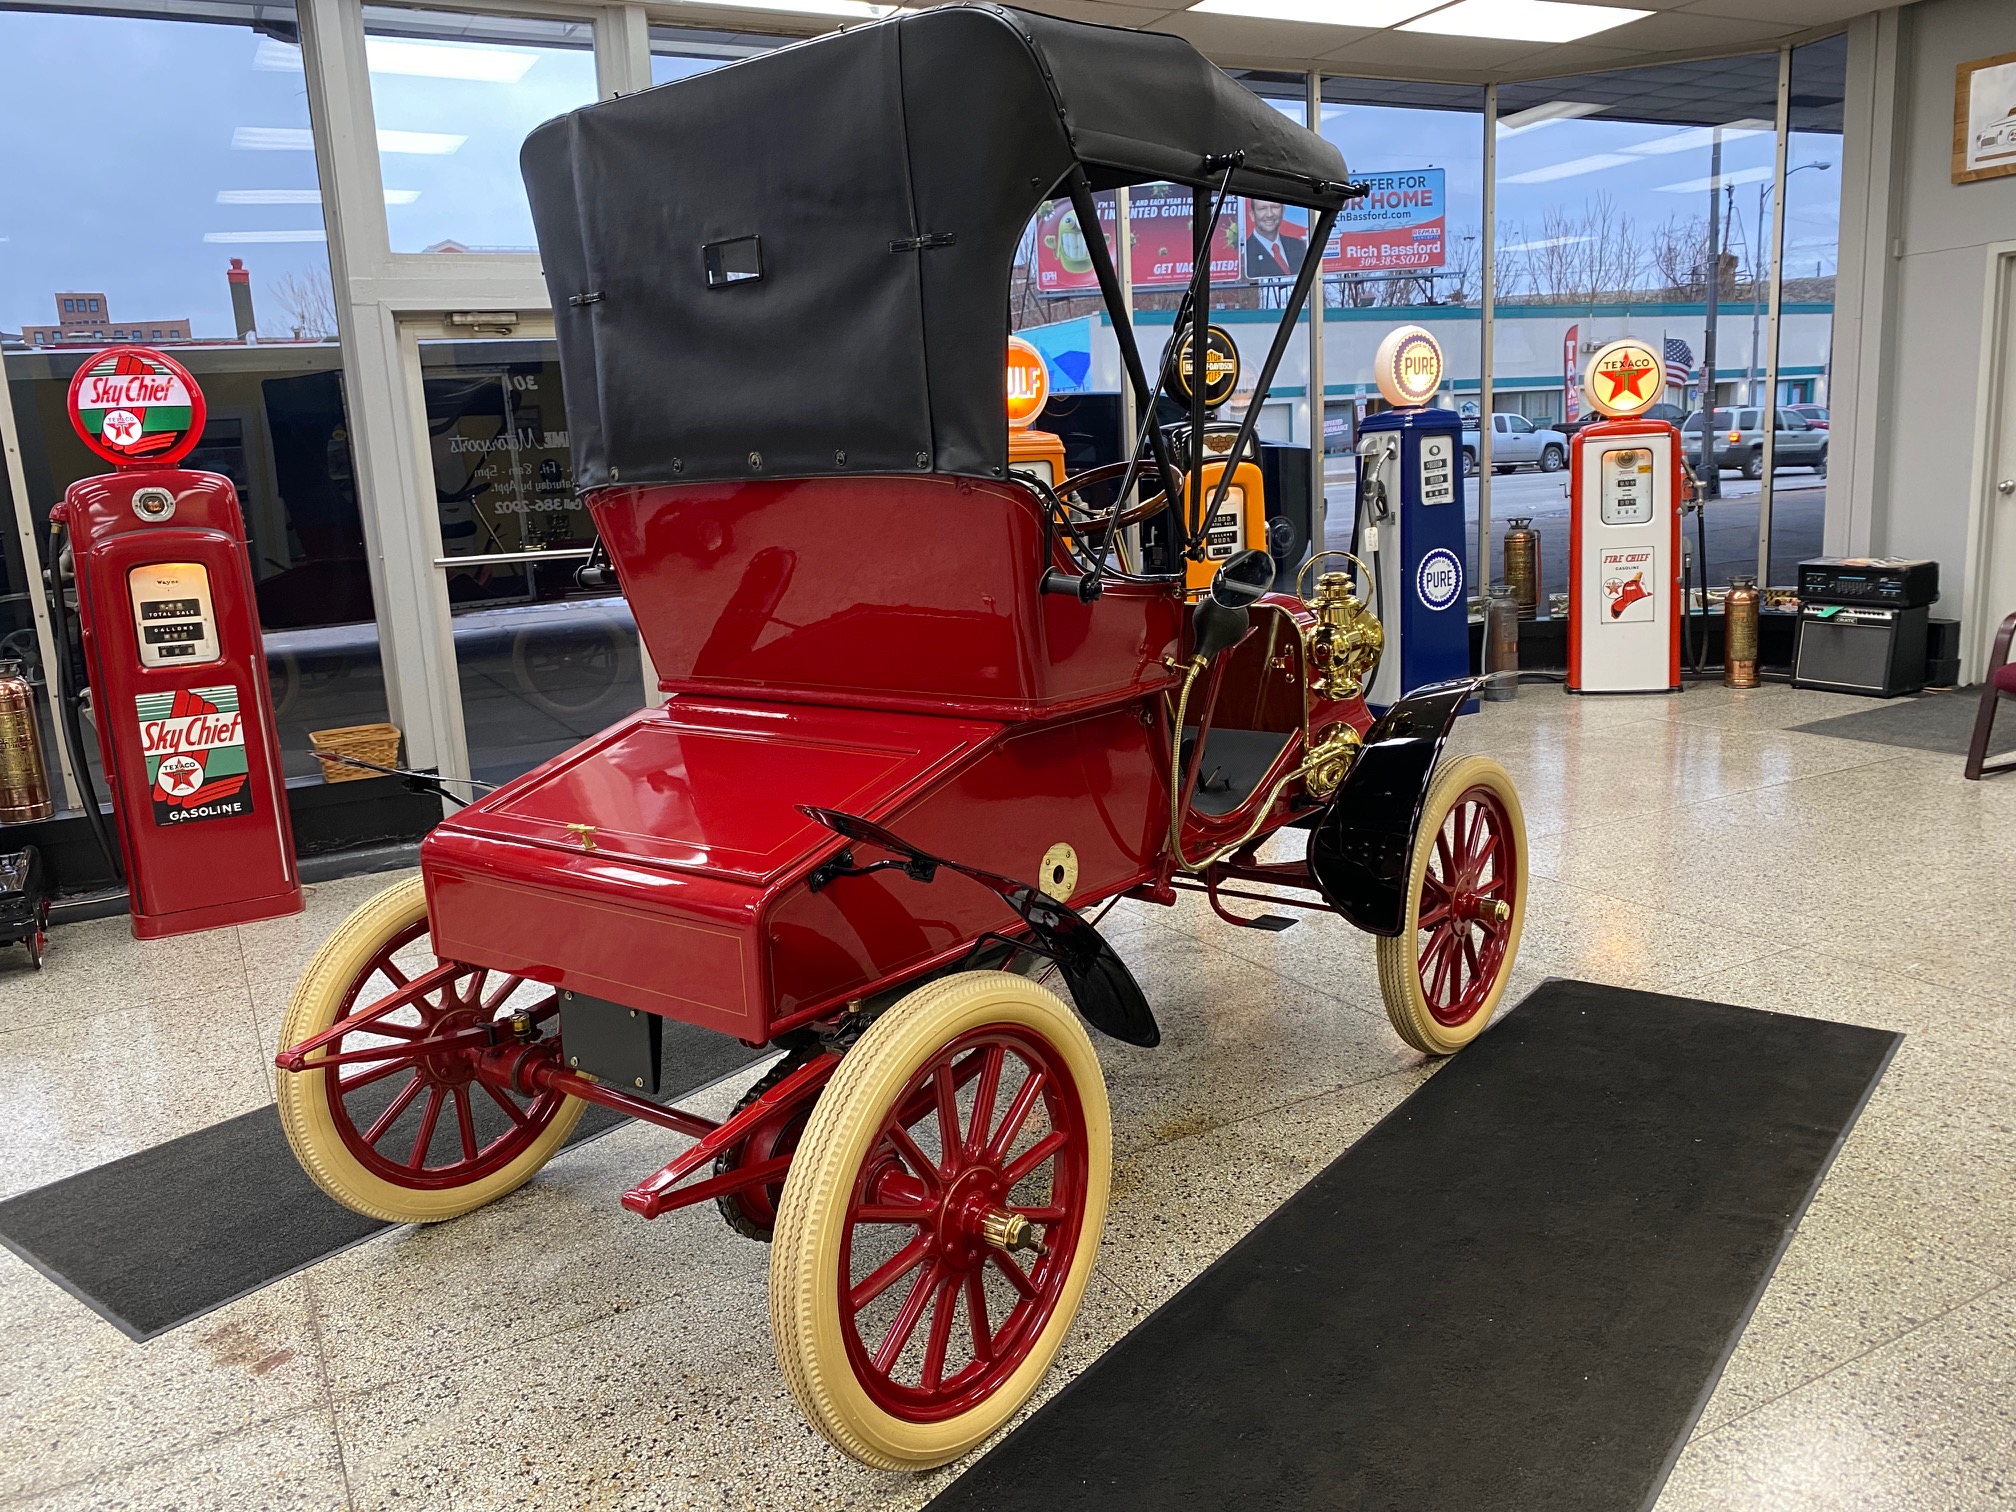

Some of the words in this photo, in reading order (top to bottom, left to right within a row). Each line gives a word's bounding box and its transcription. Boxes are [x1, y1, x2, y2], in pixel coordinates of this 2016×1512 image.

[1351, 178, 1394, 191] FER
[1398, 176, 1426, 189] FOR
[1136, 199, 1148, 207] AND
[1150, 198, 1164, 206] EACH
[1166, 197, 1182, 205] YEAR
[1371, 190, 1433, 209] HOME
[1104, 206, 1158, 220] INNTED
[1336, 210, 1411, 222] chBassford.com
[1346, 245, 1377, 258] Rich
[1381, 241, 1441, 256] Bassford
[1359, 254, 1429, 267] 309-385-SOLD
[1154, 262, 1173, 275] GET
[1404, 356, 1434, 376] PURE
[1604, 358, 1650, 370] TEXACO
[1008, 366, 1041, 399] ULF
[91, 378, 123, 407] Sky
[125, 376, 174, 402] Chief
[1603, 554, 1624, 563] FIRE
[1625, 553, 1650, 562] CHIEF
[1426, 570, 1453, 590] PURE
[154, 625, 193, 633] GALLONS
[144, 721, 184, 753] Sky
[185, 713, 241, 747] Chief
[163, 761, 196, 771] TEXACO
[170, 803, 242, 820] GASOLINE
